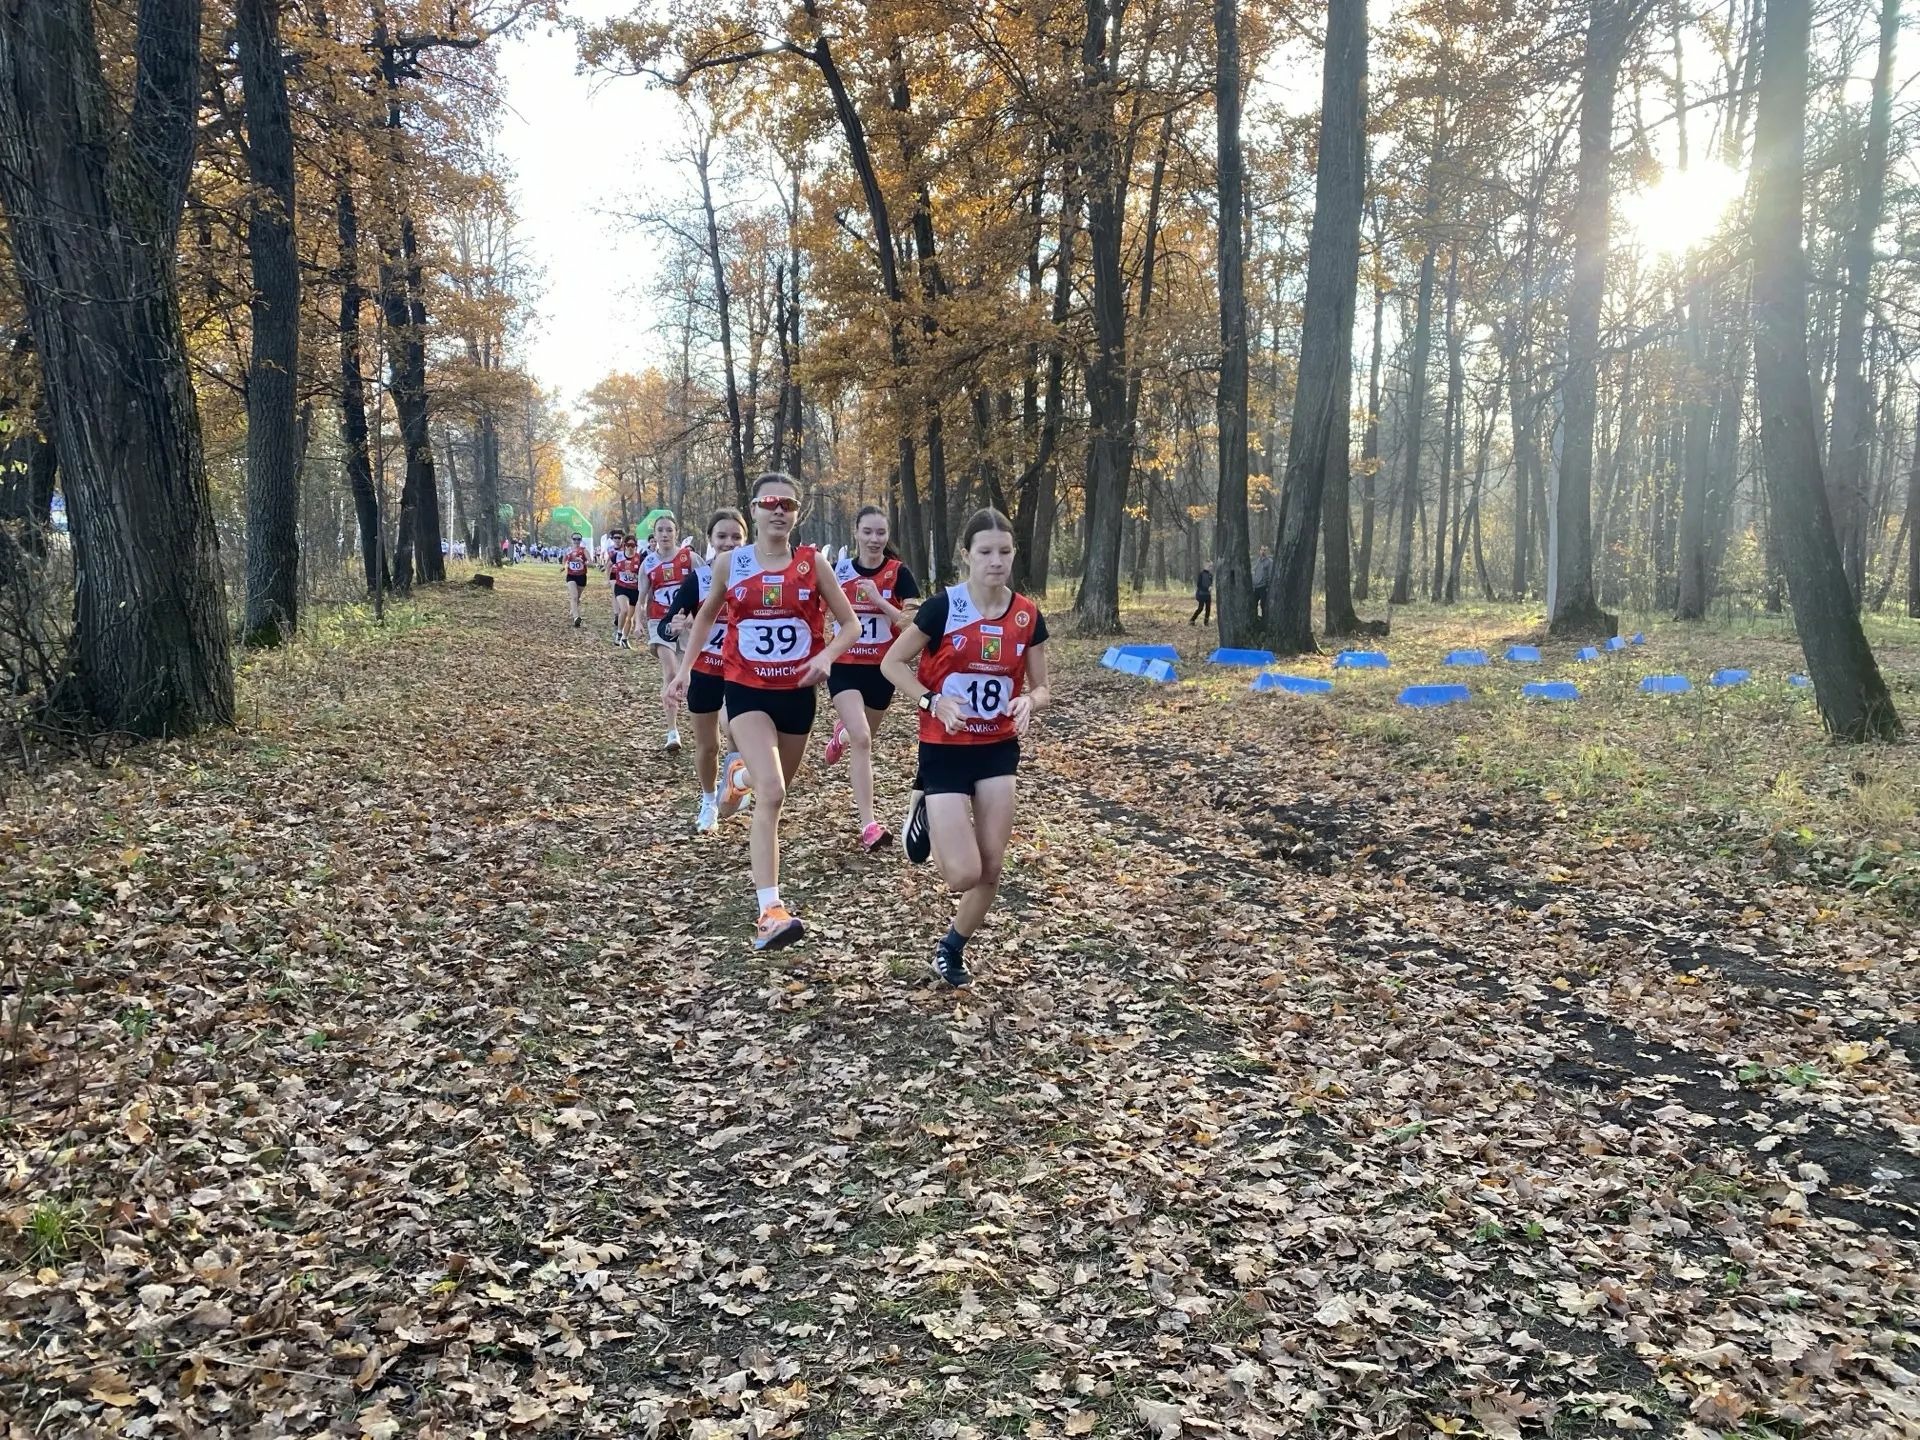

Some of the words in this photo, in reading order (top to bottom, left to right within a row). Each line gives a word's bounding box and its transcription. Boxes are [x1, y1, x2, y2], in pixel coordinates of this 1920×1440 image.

[754, 625, 797, 655] 39
[754, 665, 797, 677] ЗАИНСК
[966, 679, 1002, 713] 18
